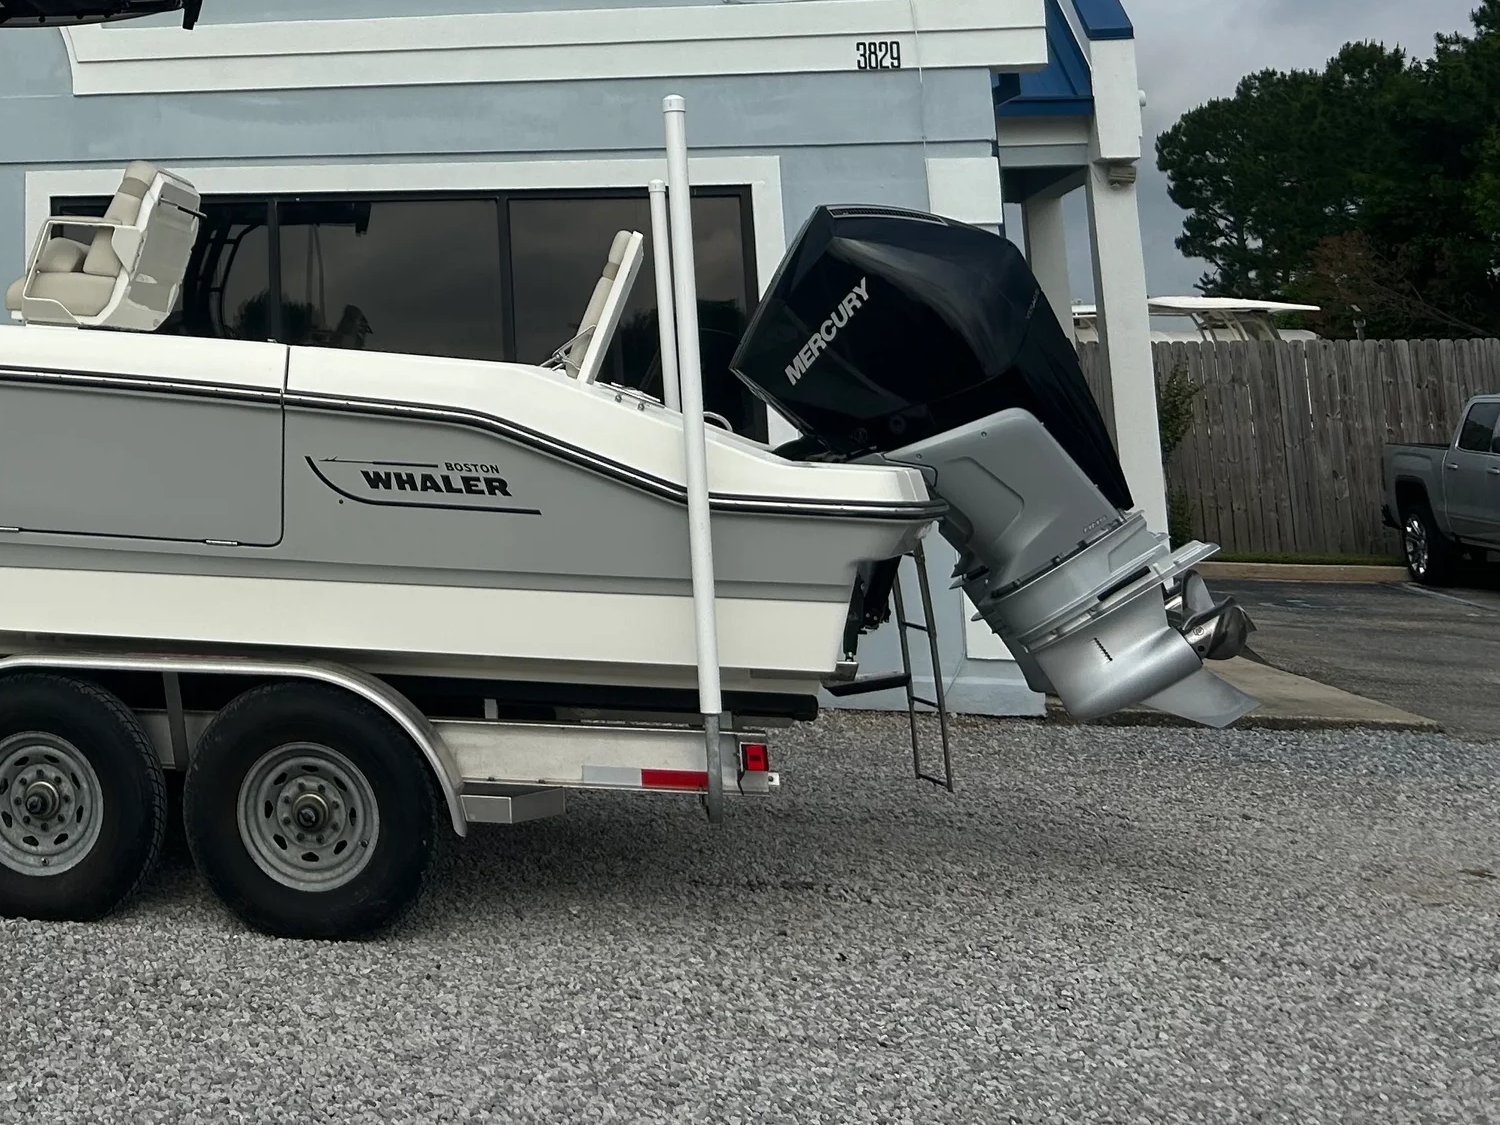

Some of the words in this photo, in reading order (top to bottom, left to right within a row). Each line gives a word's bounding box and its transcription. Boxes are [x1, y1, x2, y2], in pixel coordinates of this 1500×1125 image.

[856, 41, 901, 70] 3829
[784, 276, 869, 386] MERCURY
[444, 462, 500, 474] BOSTON
[360, 470, 512, 497] WHALER
